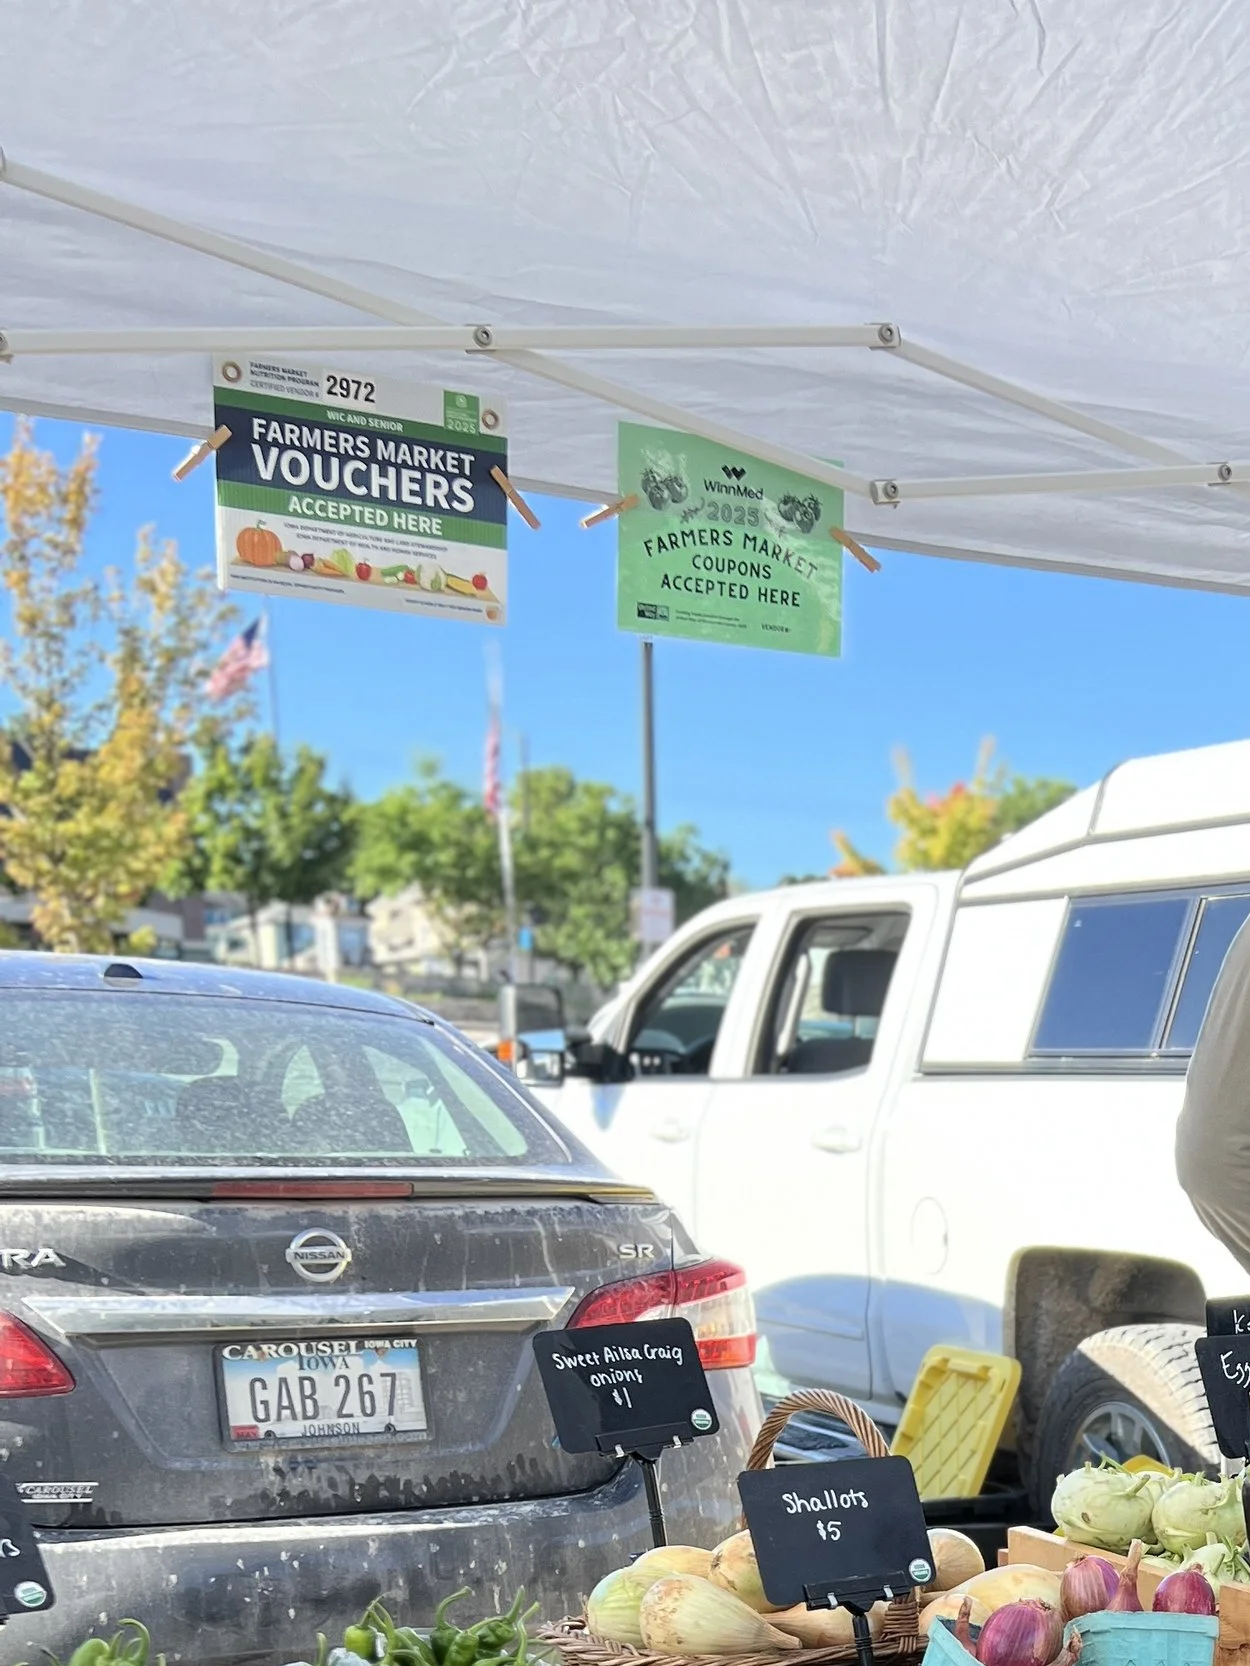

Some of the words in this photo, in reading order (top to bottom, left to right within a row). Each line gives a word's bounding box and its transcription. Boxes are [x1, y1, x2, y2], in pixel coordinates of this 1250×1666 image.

[326, 374, 376, 403] 2972
[327, 410, 347, 423] WIC
[347, 413, 367, 426] AND
[368, 416, 403, 432] SENIOR
[252, 418, 371, 459] FARMERS
[377, 439, 475, 476] MARKET
[251, 443, 475, 513] VOUCHERS
[703, 478, 764, 500] WinnMed
[288, 496, 389, 527] ACCEPTED
[393, 512, 443, 536] HERE
[706, 502, 760, 527] 2025
[643, 528, 733, 557] FARMERS
[743, 533, 819, 580] MARKET
[692, 554, 772, 580] COUPONS
[661, 574, 749, 600] ACCEPTED
[758, 587, 801, 608] HERE
[0, 1248, 67, 1270] RA
[294, 1251, 345, 1260] NISSAN
[618, 1243, 654, 1259] SR
[222, 1340, 363, 1360] CAROUSEL
[364, 1339, 390, 1349] IOWA
[392, 1339, 417, 1349] CITY
[552, 1351, 600, 1370] Sweet
[604, 1345, 643, 1363] Ailsa
[644, 1343, 683, 1366] Craig
[297, 1356, 350, 1371] IOWA
[590, 1368, 643, 1387] onions
[249, 1376, 319, 1424] GAB
[334, 1372, 396, 1418] 267
[612, 1386, 633, 1409] $1
[301, 1421, 361, 1436] JOHNSON
[25, 1485, 94, 1495] CAROUSEL
[782, 1488, 869, 1514] Shallots
[816, 1519, 841, 1541] $5
